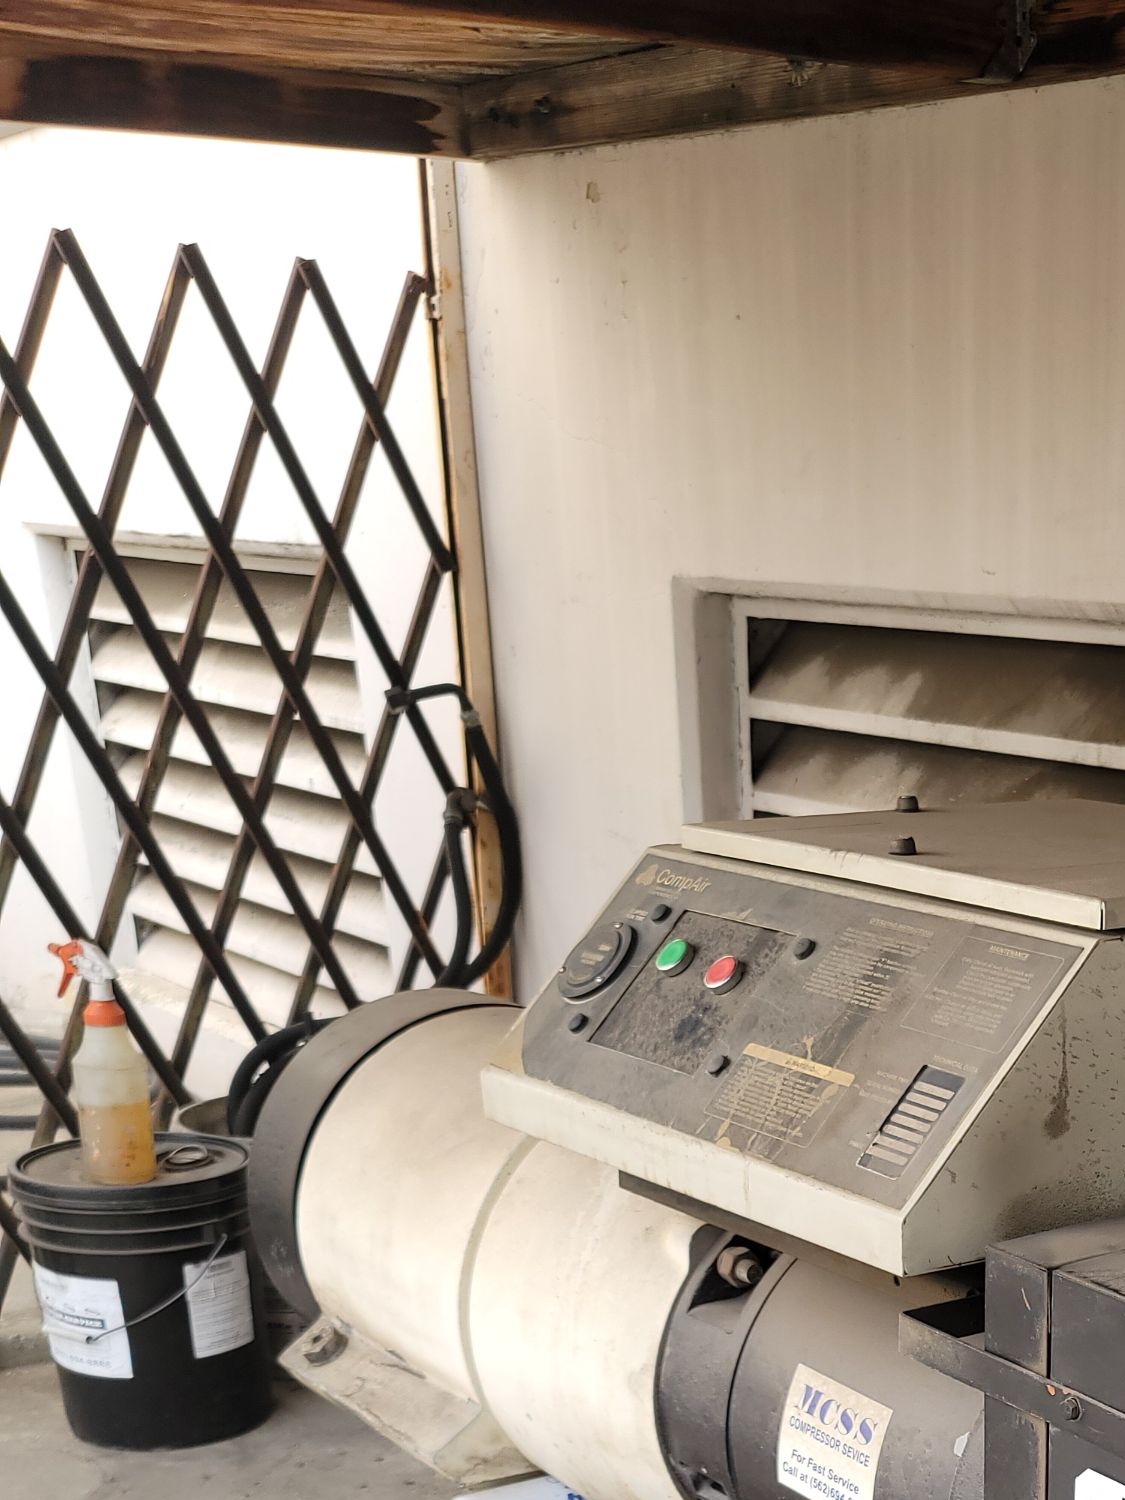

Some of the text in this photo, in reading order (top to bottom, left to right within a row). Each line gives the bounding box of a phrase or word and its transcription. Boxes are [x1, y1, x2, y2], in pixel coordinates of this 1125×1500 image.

[656, 868, 712, 892] CompAir
[794, 1383, 879, 1446] MCSS
[789, 1415, 871, 1468] COMPRESSOR SEVICE
[782, 1461, 798, 1478] Call
[799, 1473, 809, 1484] at
[790, 1449, 860, 1495] For Fast Service
